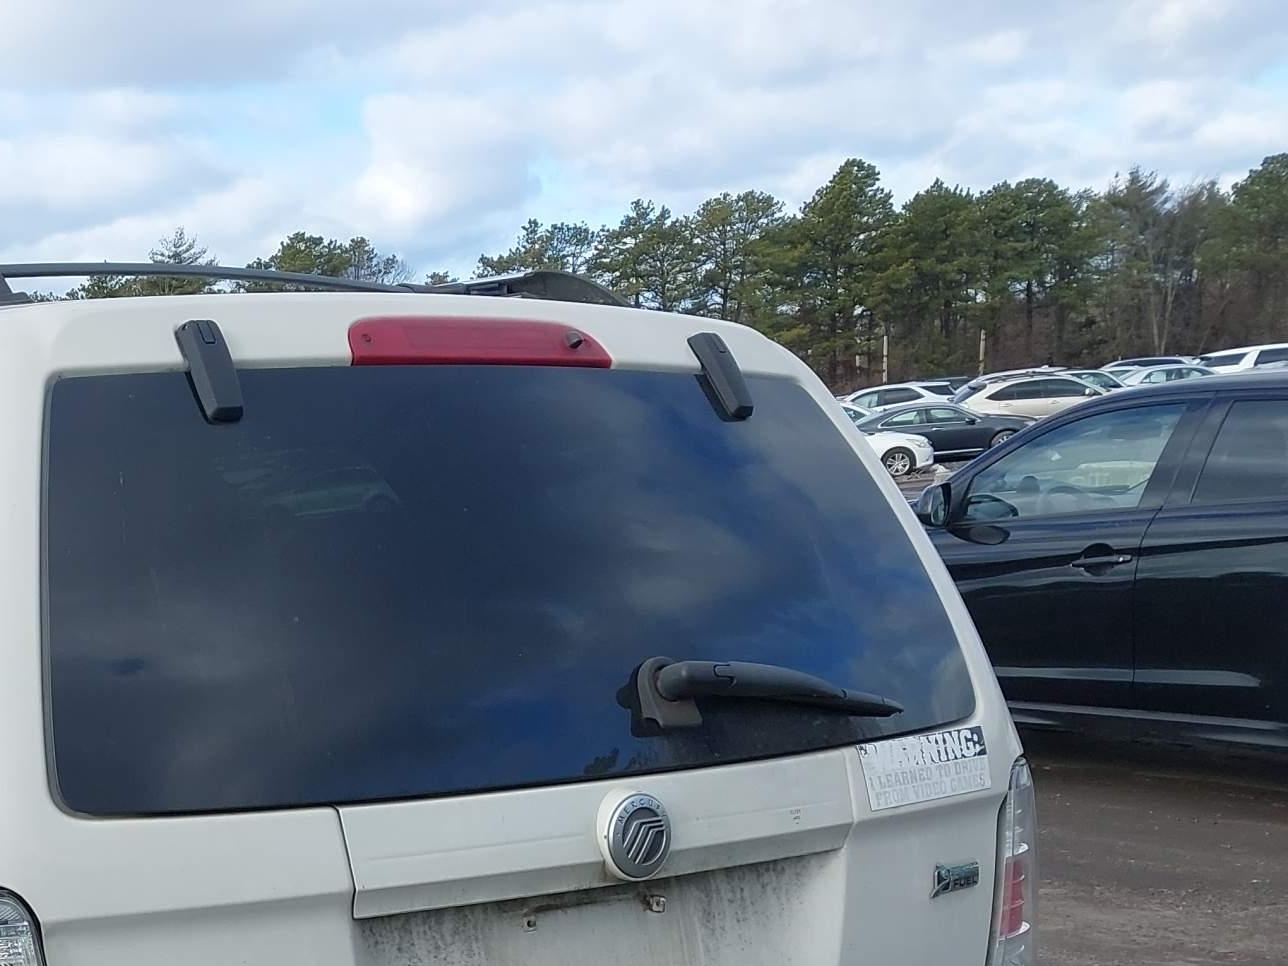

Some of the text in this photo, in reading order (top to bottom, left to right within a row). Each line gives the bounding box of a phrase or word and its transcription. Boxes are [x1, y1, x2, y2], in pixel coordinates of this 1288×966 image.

[859, 729, 981, 771] NING:
[875, 772, 986, 807] FROM VIDEO GAMES
[878, 767, 933, 790] LEARNED
[936, 764, 951, 779] TO
[954, 758, 986, 776] DRIVE
[616, 798, 666, 825] MERCUR
